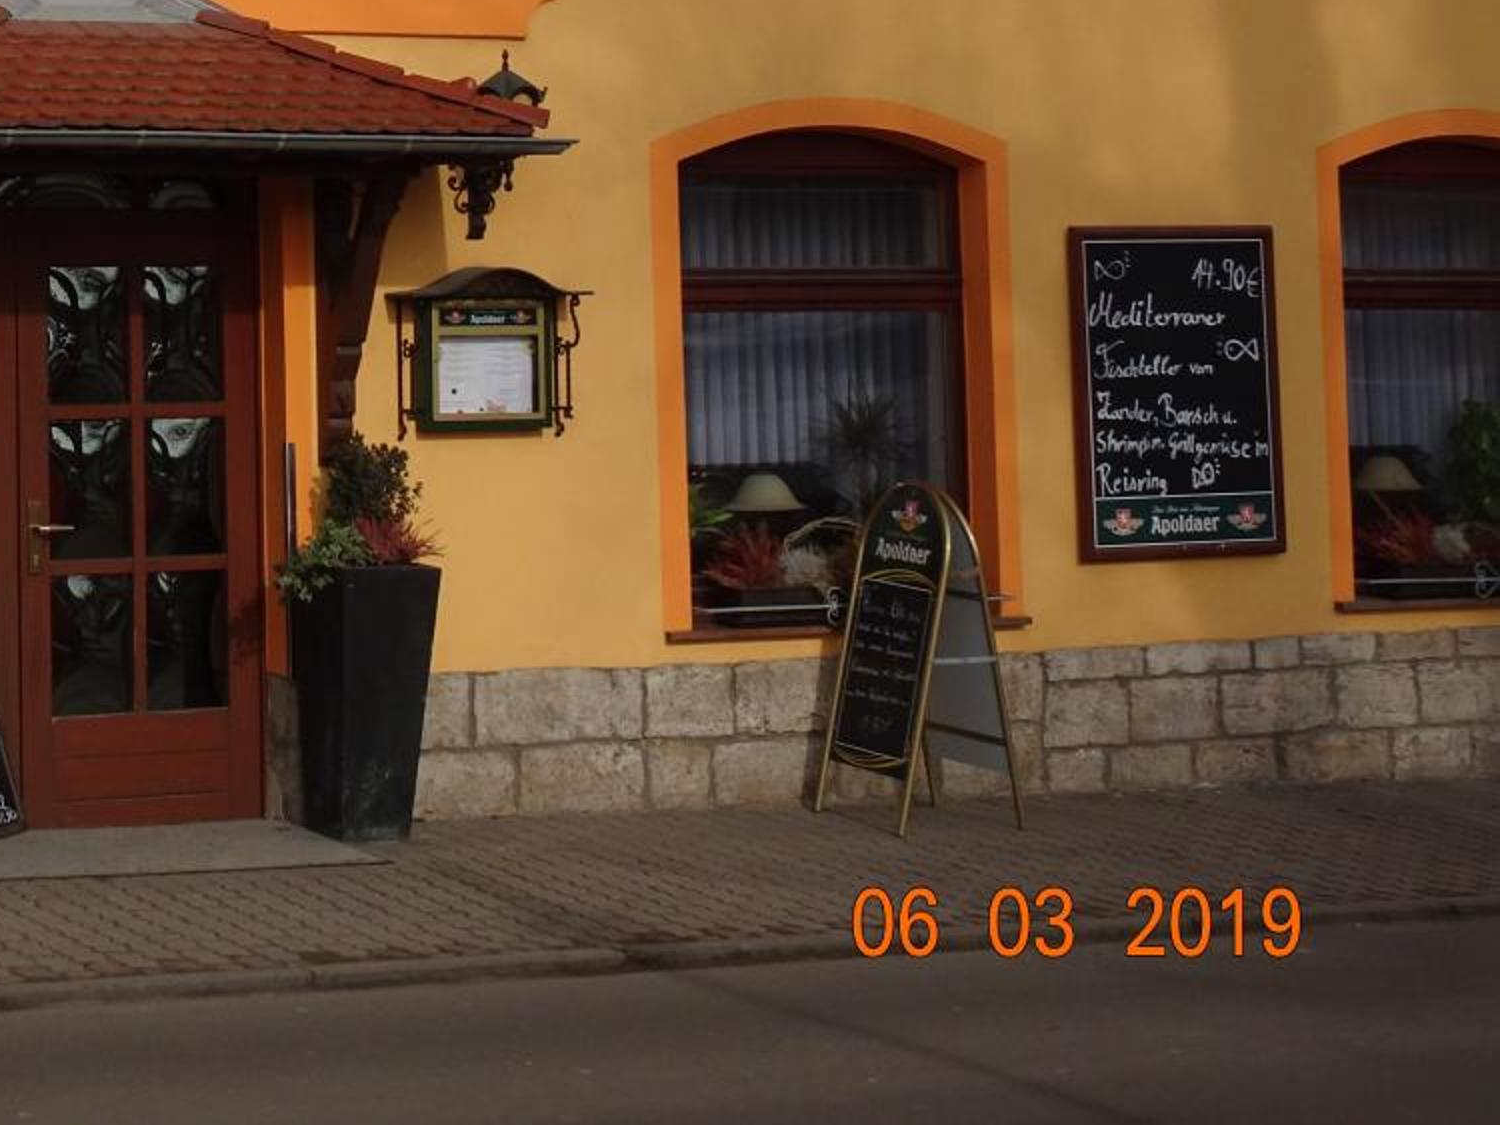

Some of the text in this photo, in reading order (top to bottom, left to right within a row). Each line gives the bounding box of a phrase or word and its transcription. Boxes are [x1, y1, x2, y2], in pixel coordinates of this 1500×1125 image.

[1089, 291, 1226, 328] Mediterraner
[1157, 392, 1219, 427] Barsch
[1151, 514, 1220, 537] Apoldaer
[875, 536, 932, 565] Apoldaer
